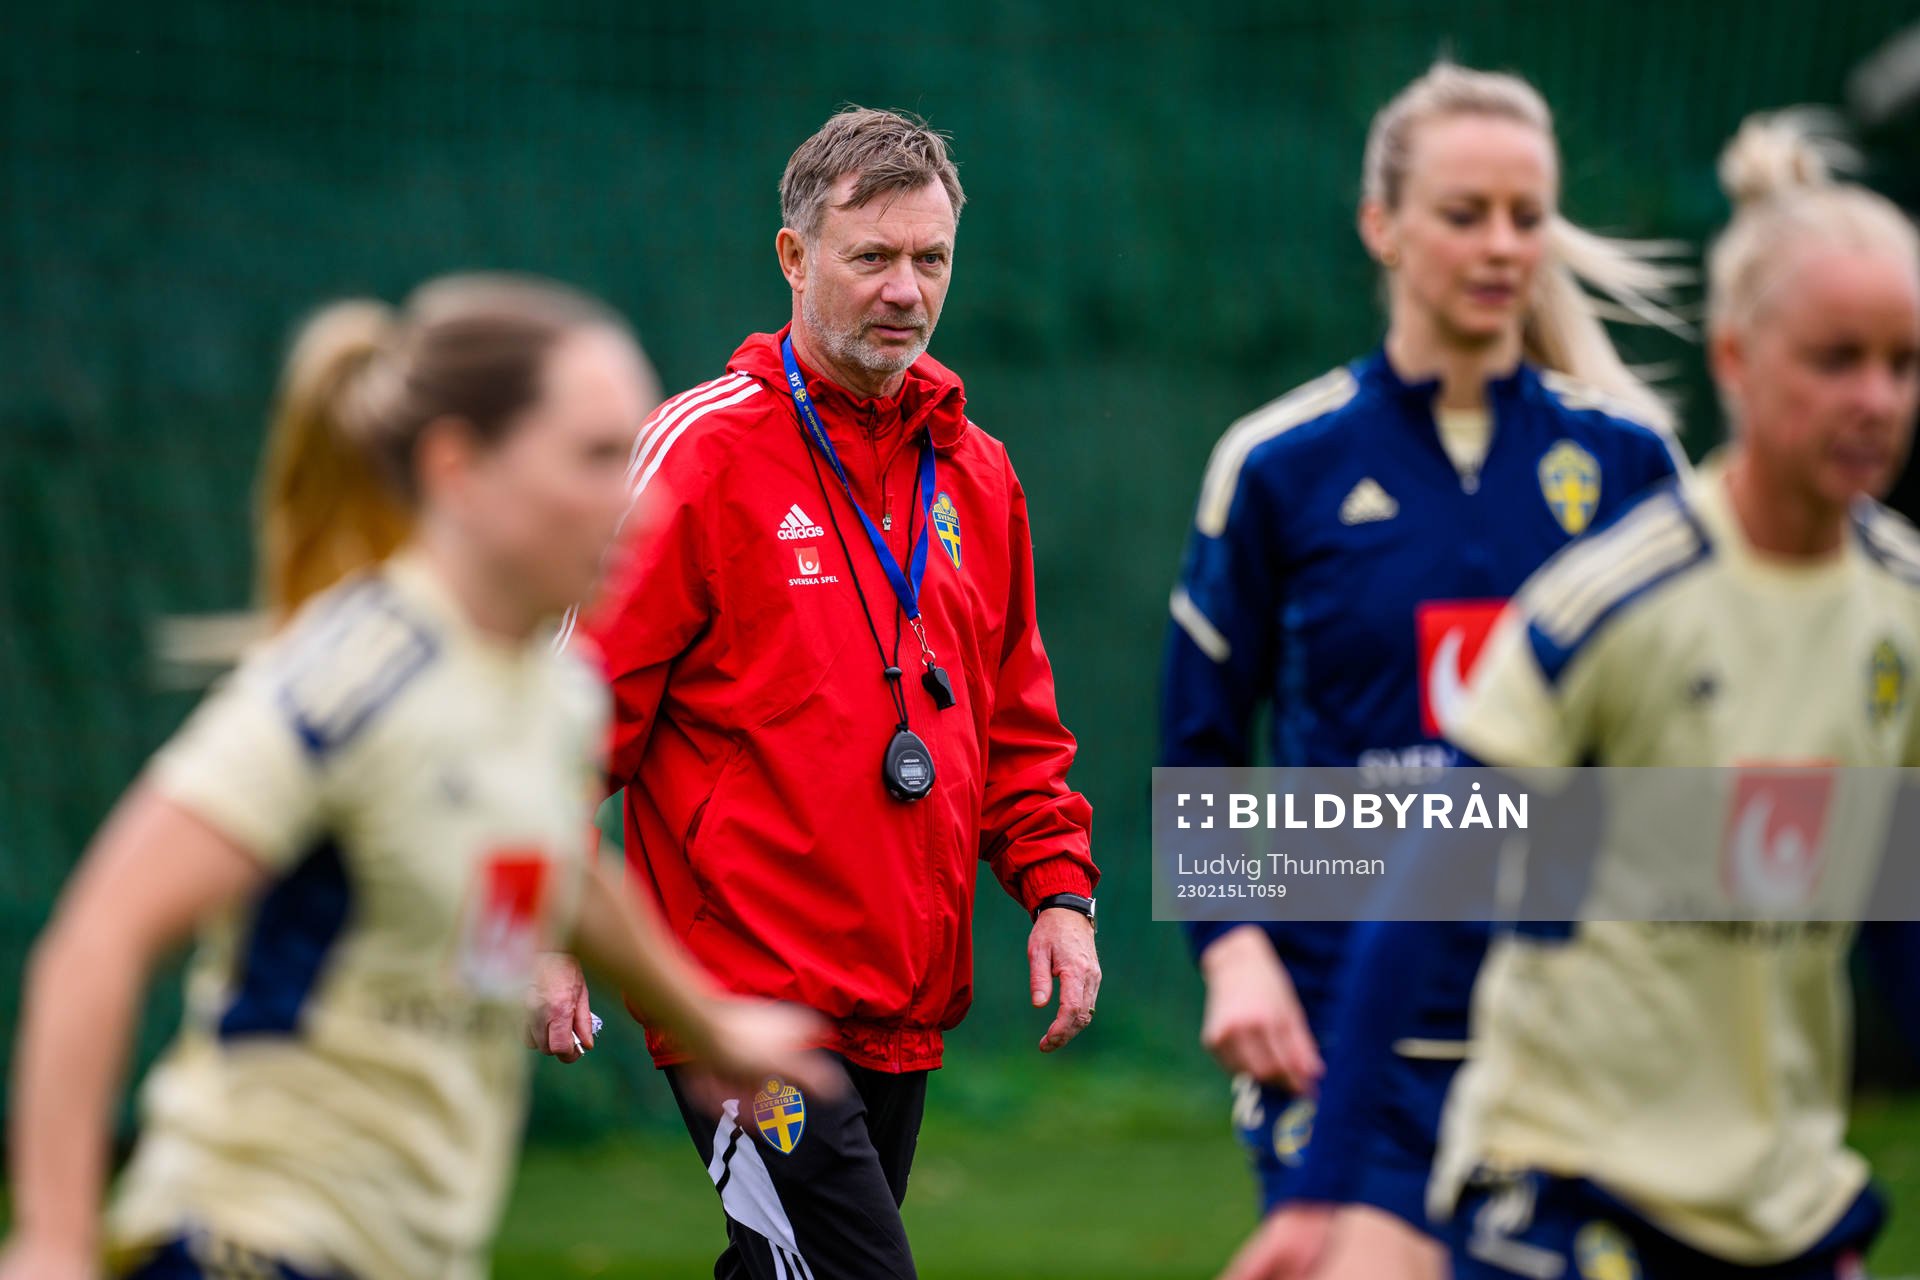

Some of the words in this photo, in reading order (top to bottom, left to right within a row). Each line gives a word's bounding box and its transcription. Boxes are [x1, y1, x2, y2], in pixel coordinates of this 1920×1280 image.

[777, 525, 824, 541] adidas
[788, 577, 819, 587] SVENSKA
[821, 575, 839, 584] SPEL
[759, 1096, 795, 1110] SVERIGE
